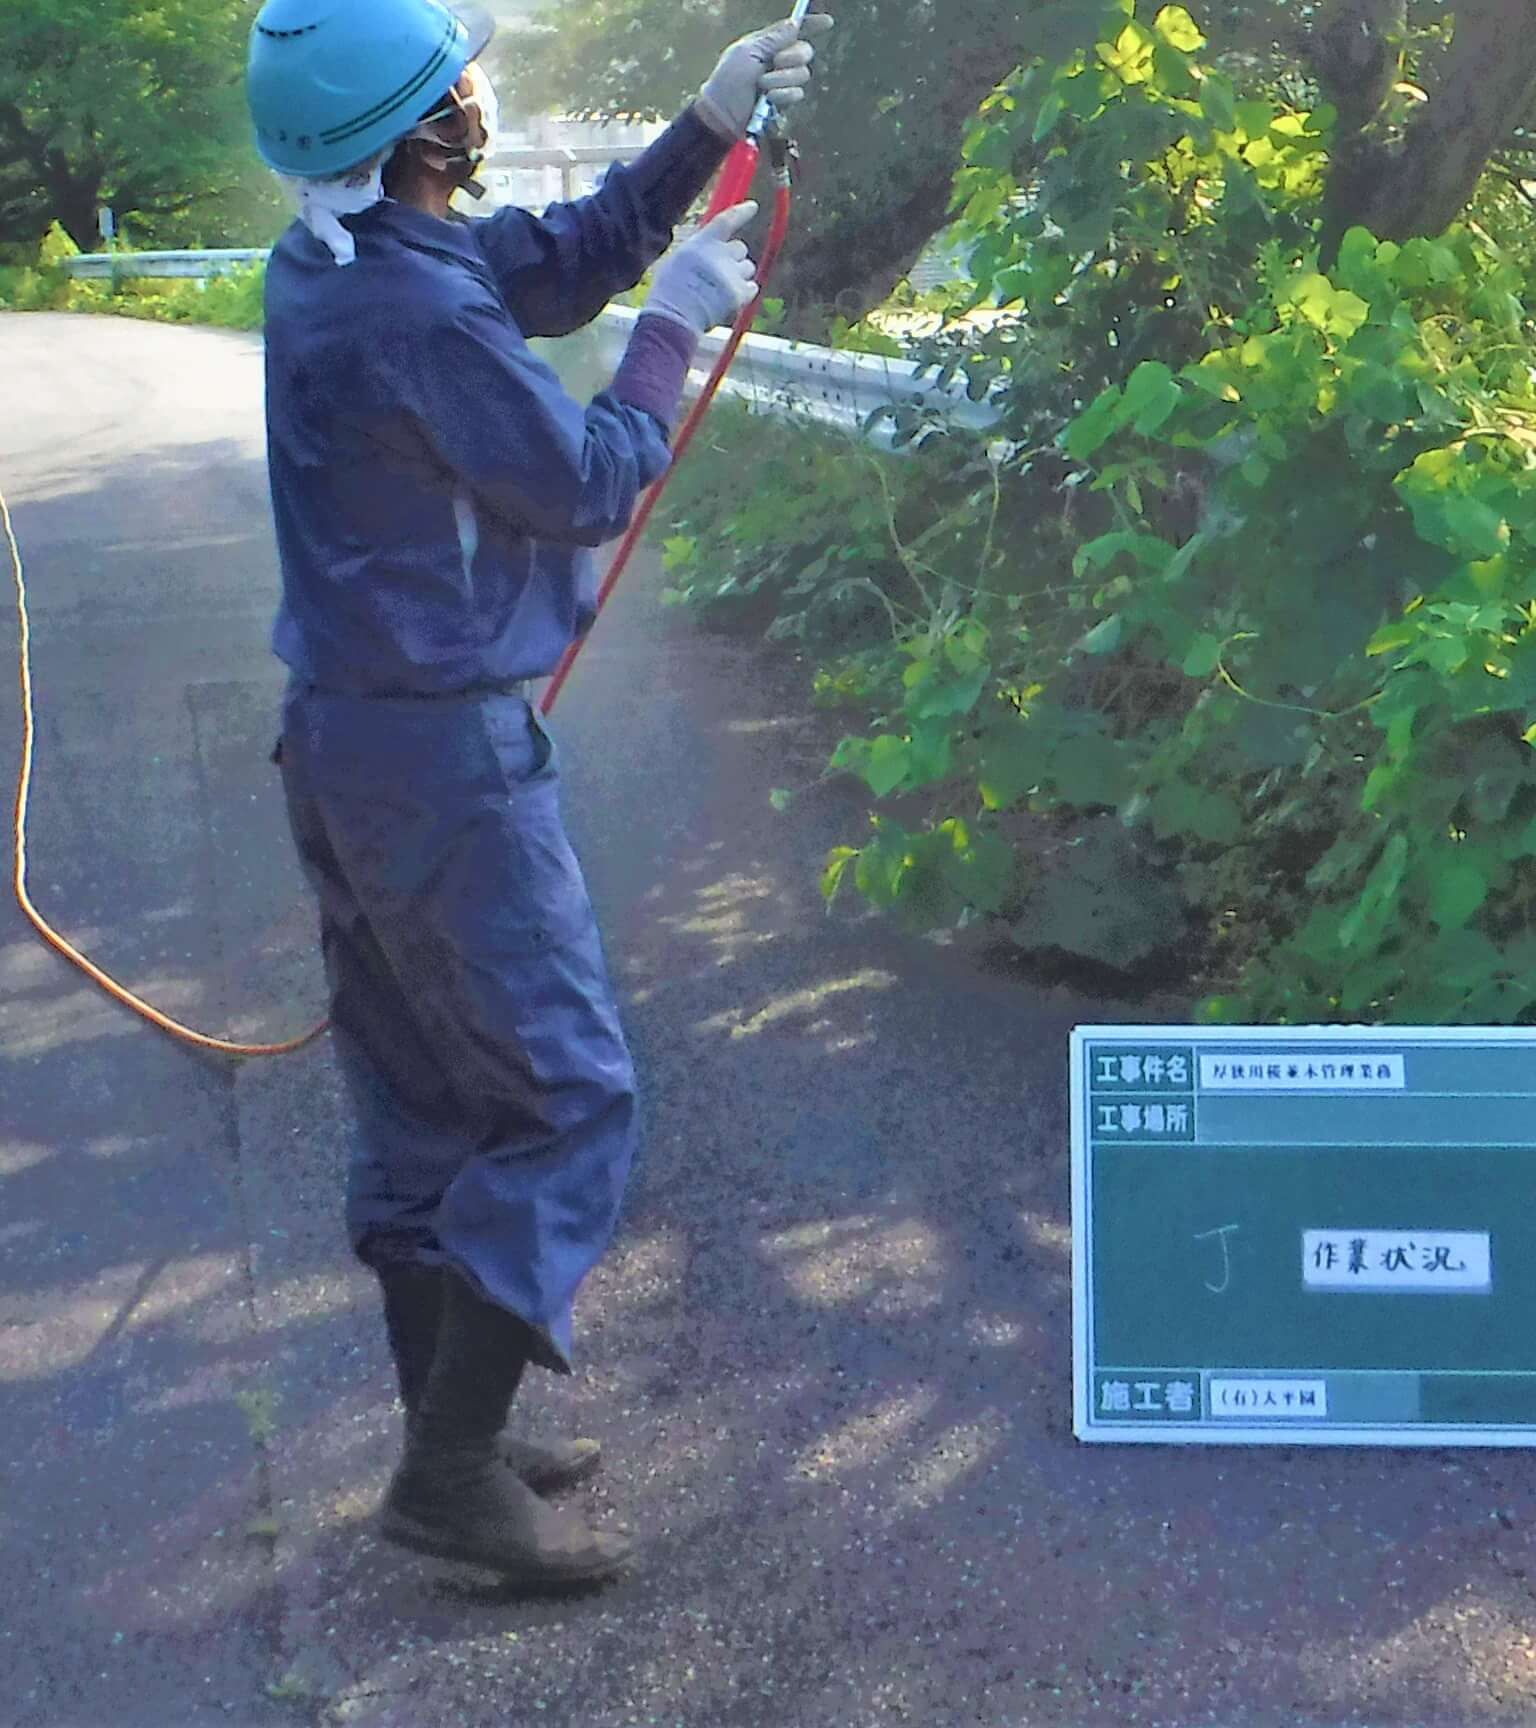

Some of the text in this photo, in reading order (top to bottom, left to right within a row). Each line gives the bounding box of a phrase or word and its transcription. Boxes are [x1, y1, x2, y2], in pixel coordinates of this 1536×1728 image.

[1096, 1055, 1188, 1083] 工事件名
[1096, 1103, 1188, 1133] 工事場所
[1314, 1238, 1467, 1274] 作業状況
[1100, 1380, 1195, 1412] 施工者
